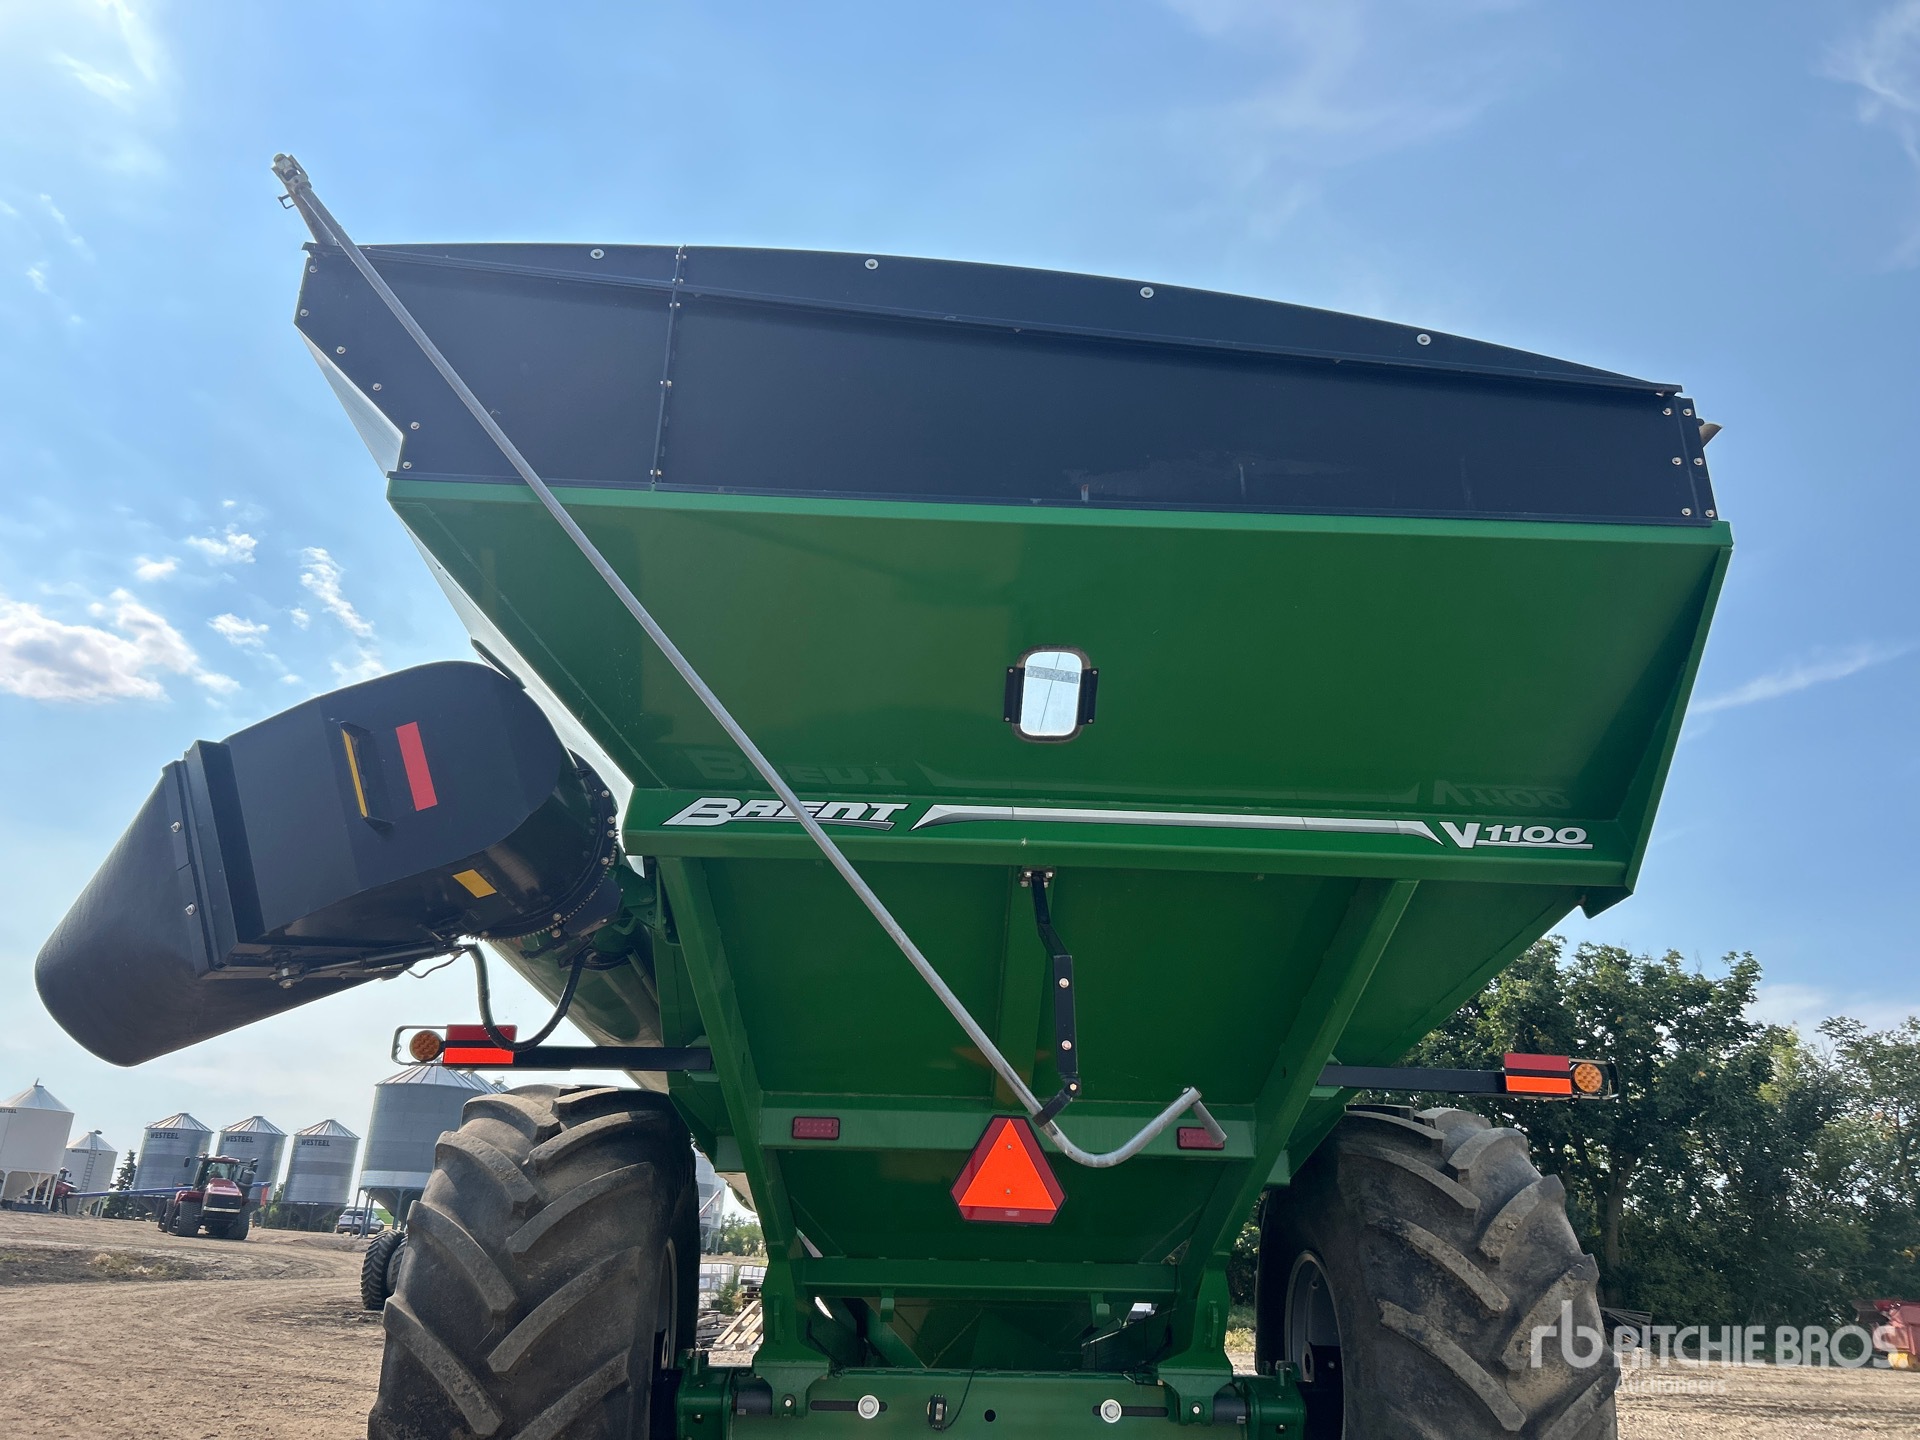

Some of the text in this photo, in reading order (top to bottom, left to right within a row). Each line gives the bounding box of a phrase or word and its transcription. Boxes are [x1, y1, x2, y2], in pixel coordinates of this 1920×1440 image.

[661, 797, 909, 826] BRENT
[1438, 821, 1592, 849] V1100
[150, 1131, 180, 1140] WESTEEL
[225, 1135, 254, 1143] WESTEEL
[301, 1138, 330, 1147] WESTEEL
